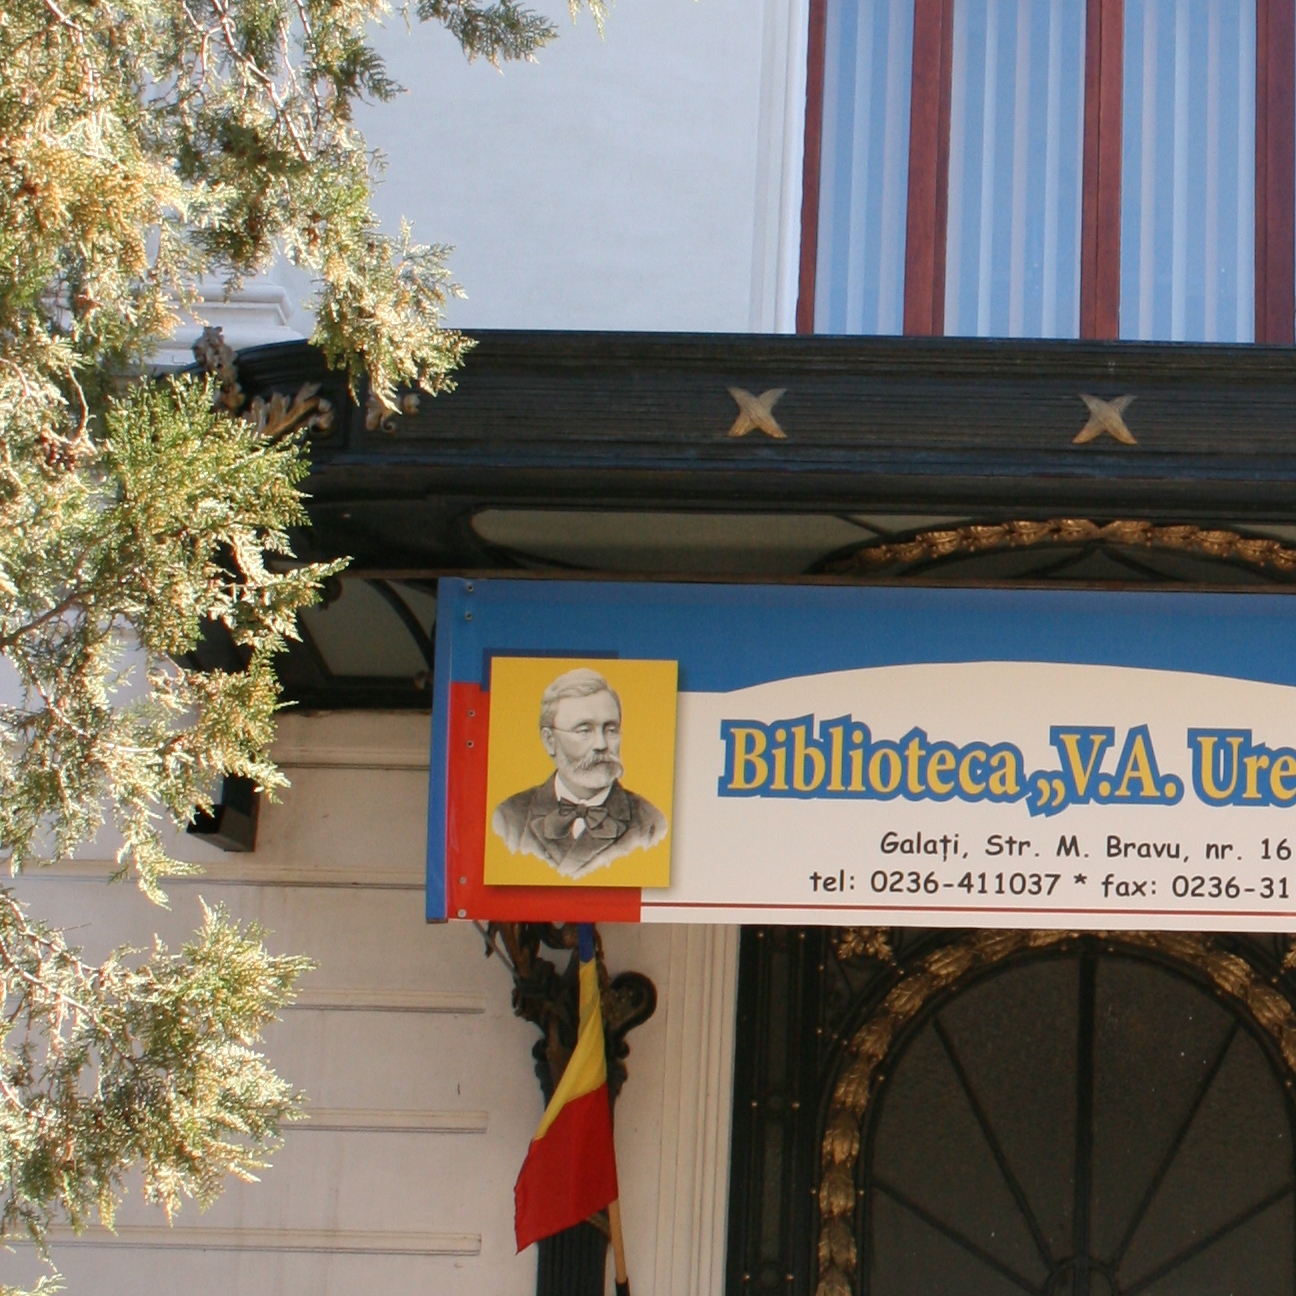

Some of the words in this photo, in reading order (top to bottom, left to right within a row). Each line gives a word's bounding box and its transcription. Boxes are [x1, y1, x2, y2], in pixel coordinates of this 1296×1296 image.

[724, 722, 1023, 797] Biblioteca
[983, 833, 1041, 858] Str.
[1055, 835, 1090, 858] M.
[1105, 835, 1191, 863] Bravu,
[1204, 840, 1243, 861] nr.
[1259, 838, 1293, 861] 16
[808, 868, 856, 893] tel:
[869, 869, 1062, 896] 0236-411037
[1101, 873, 1157, 898] fax:
